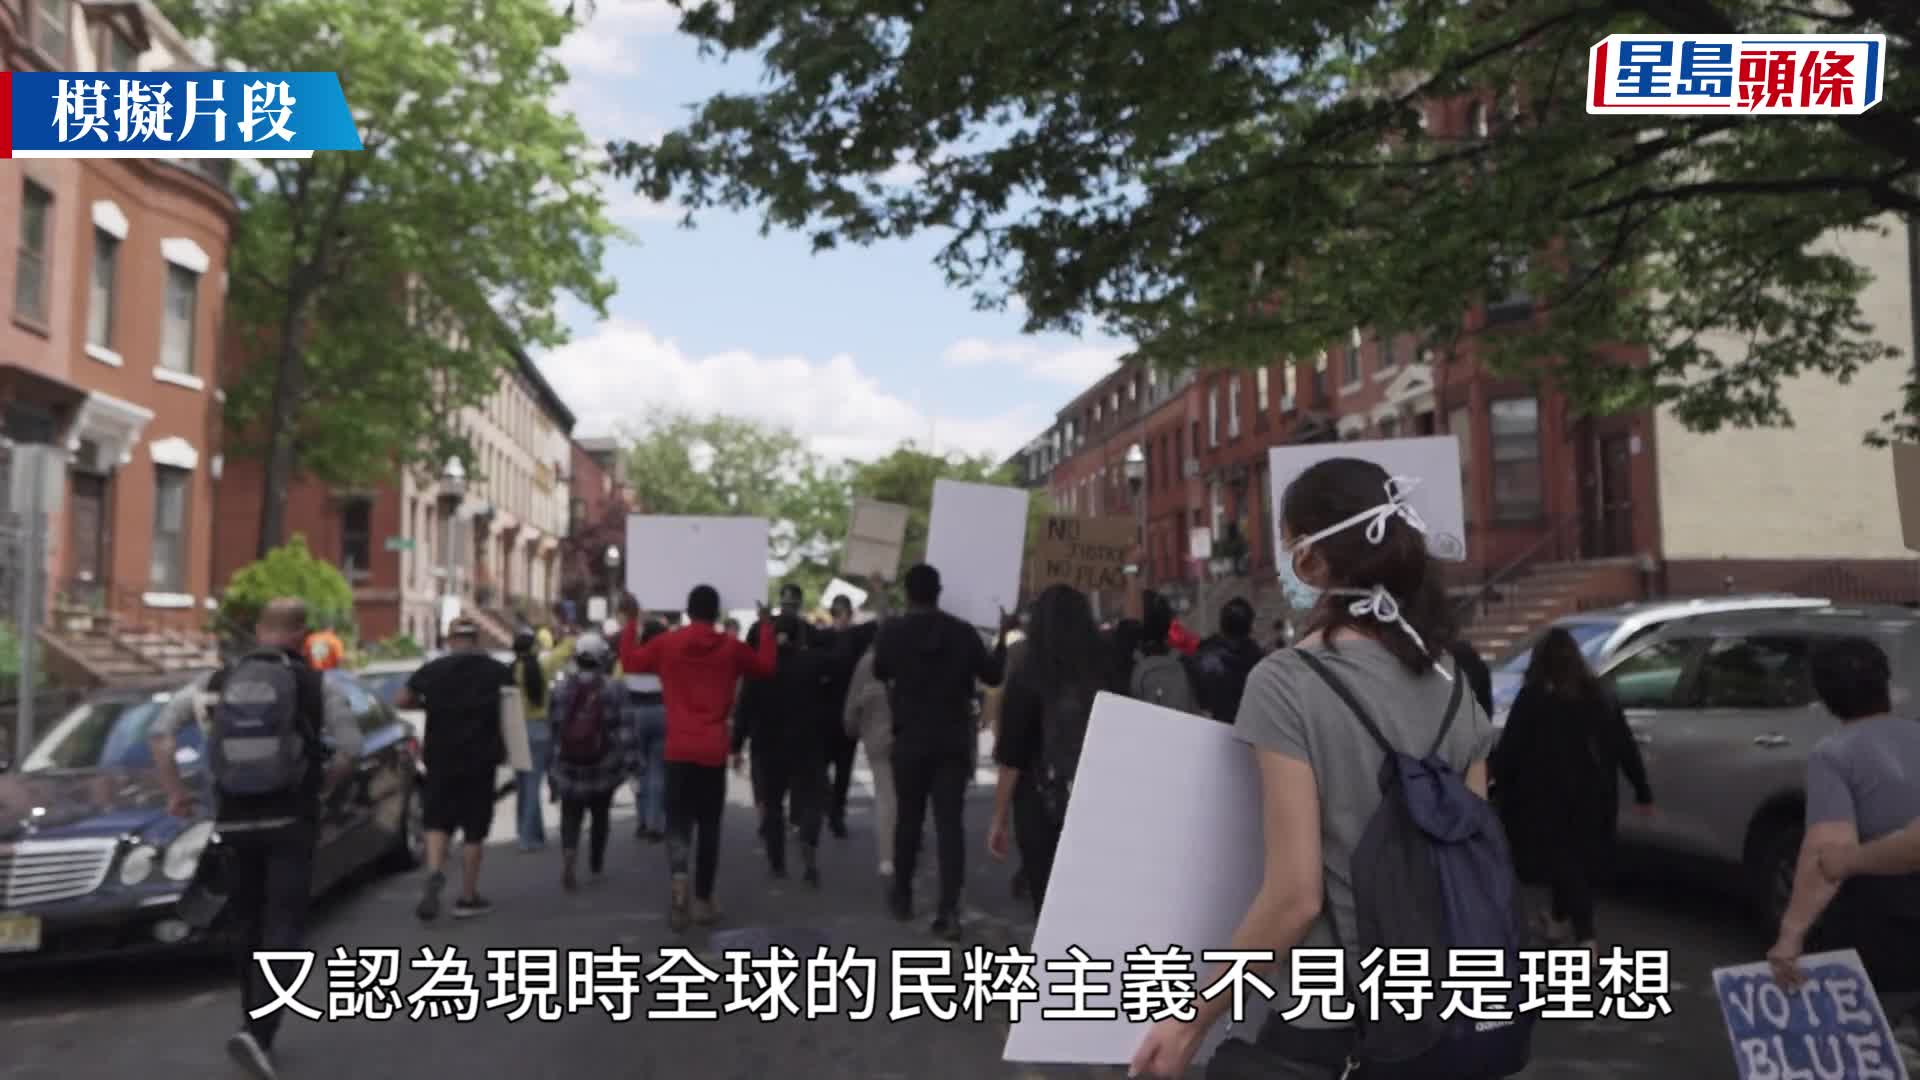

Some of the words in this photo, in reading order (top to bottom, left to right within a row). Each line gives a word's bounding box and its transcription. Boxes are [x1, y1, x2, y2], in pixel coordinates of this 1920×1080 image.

[1047, 516, 1080, 541] NO
[1047, 559, 1072, 577] NO
[1728, 977, 1873, 1030] VOTE
[1740, 1031, 1896, 1080] BLUE
